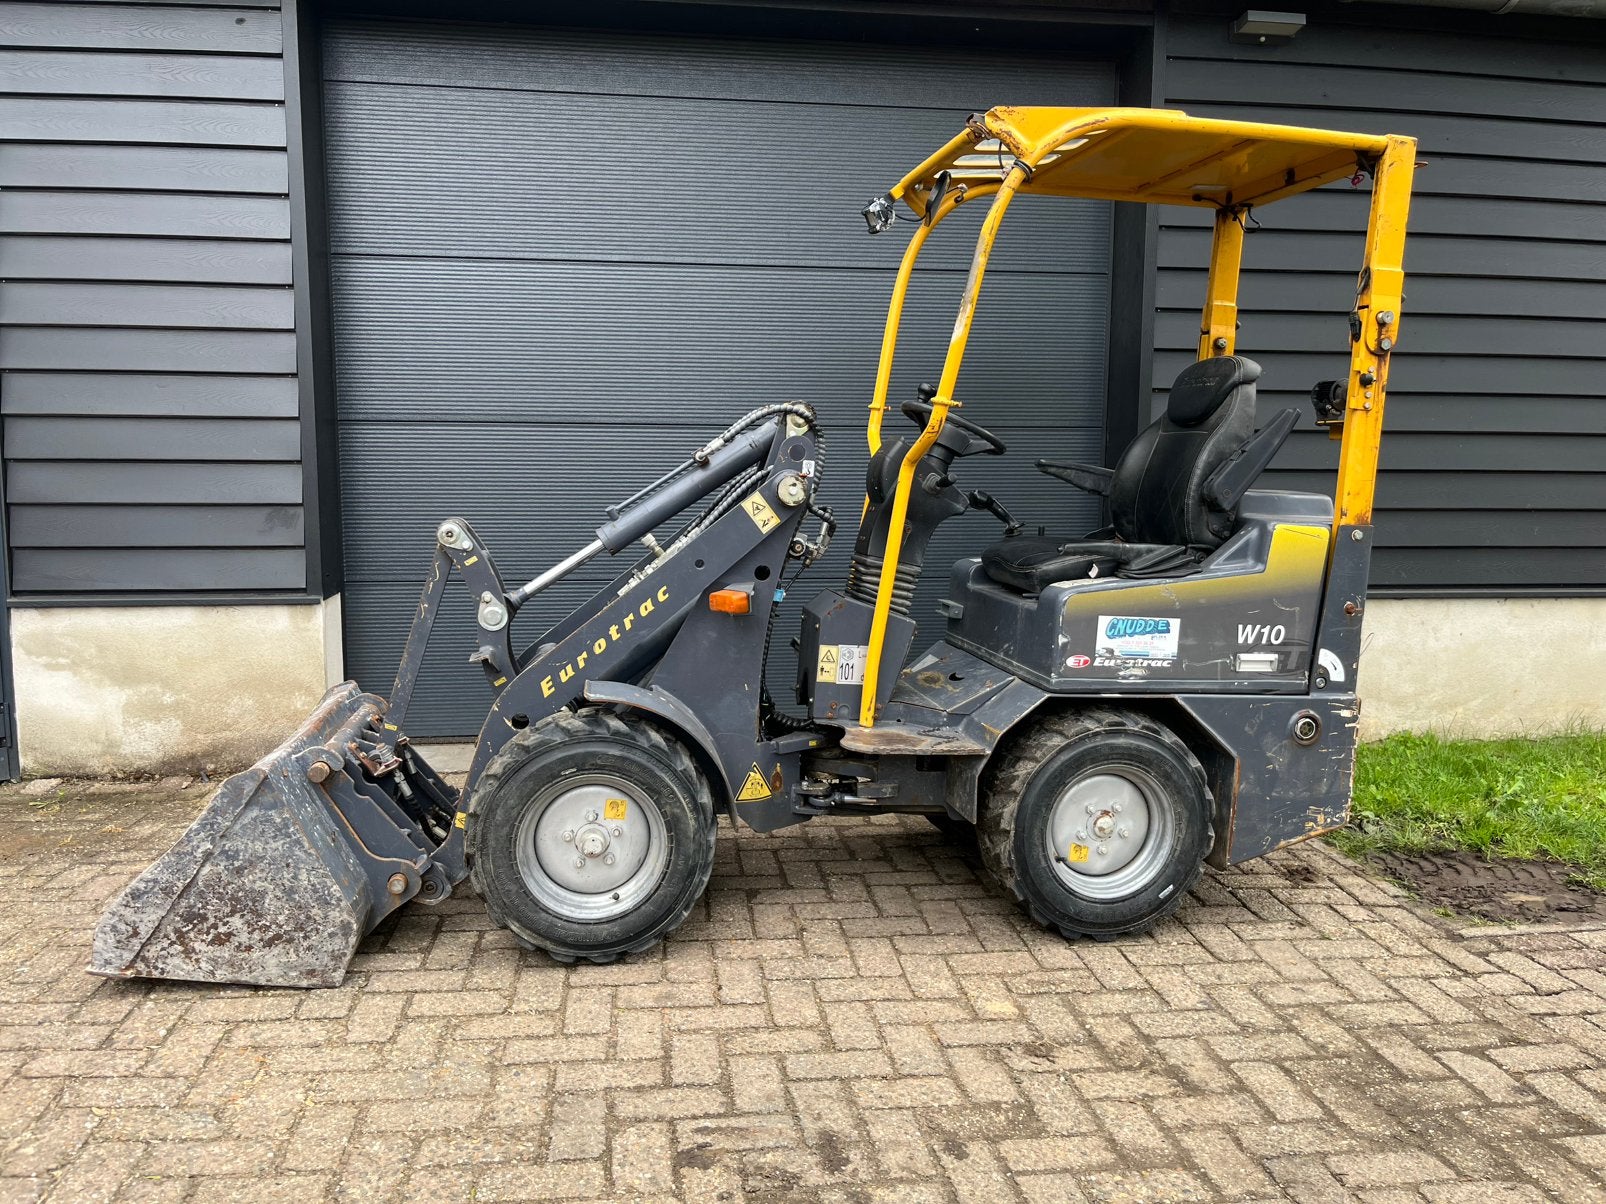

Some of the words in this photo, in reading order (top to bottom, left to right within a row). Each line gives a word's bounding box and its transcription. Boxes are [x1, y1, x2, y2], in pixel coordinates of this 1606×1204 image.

[1105, 617, 1170, 639] CNUDDE
[1237, 624, 1286, 645] W10
[540, 585, 669, 698] Eurotrac
[839, 662, 855, 680] 101
